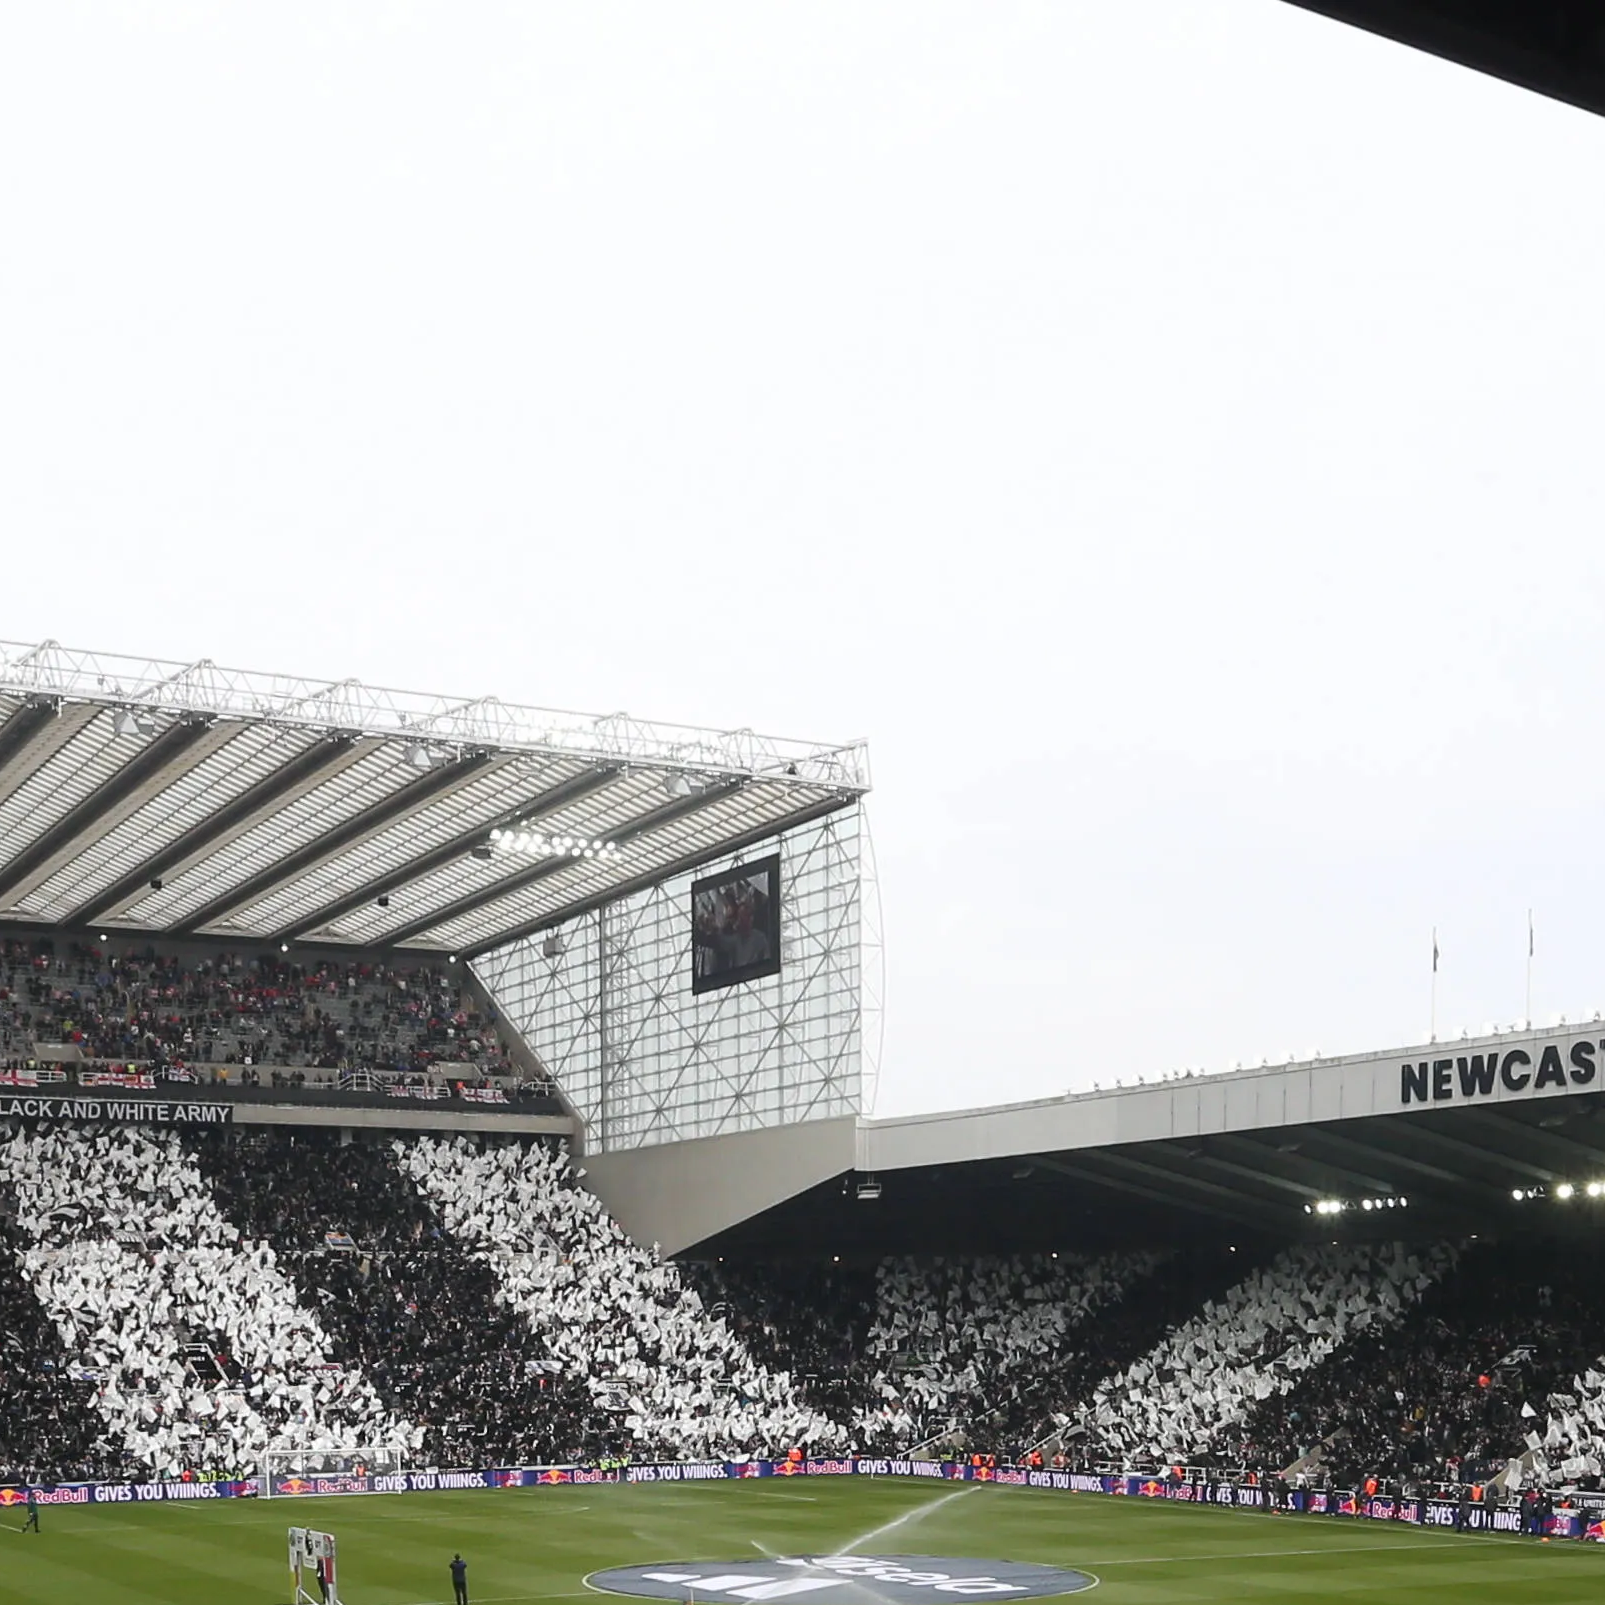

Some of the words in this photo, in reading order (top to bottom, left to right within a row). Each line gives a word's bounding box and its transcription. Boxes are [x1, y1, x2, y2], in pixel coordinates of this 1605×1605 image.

[58, 1101, 101, 1119] AND
[106, 1103, 170, 1121] WHITE
[173, 1105, 230, 1123] ARMY
[658, 1464, 681, 1480] YOU
[807, 1461, 828, 1474] Red
[828, 1461, 853, 1474] Bull
[857, 1460, 888, 1474] GIVES
[890, 1460, 911, 1475] YOU
[374, 1476, 407, 1491] GIVES
[410, 1474, 436, 1490] YOU
[1029, 1471, 1051, 1487] GIVES
[1052, 1473, 1069, 1489] YOU
[33, 1488, 62, 1504] Red
[62, 1487, 89, 1503] Bull
[95, 1485, 133, 1502] GIVES
[135, 1483, 164, 1501] YOU
